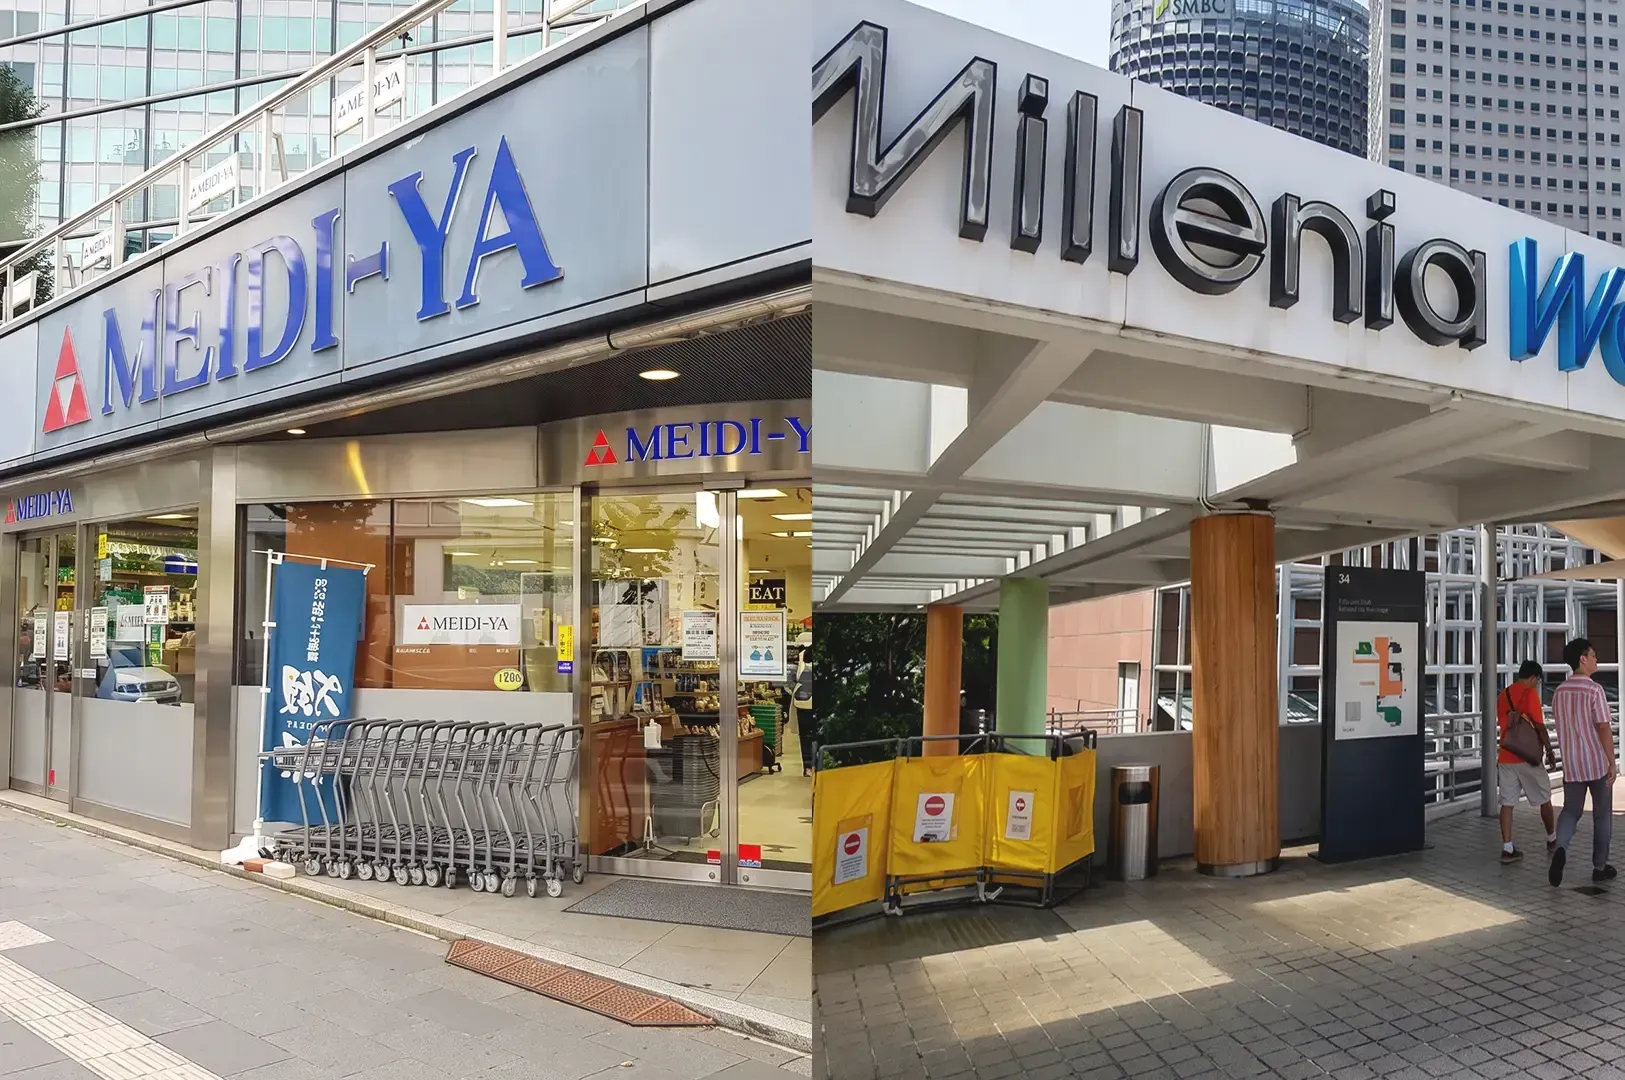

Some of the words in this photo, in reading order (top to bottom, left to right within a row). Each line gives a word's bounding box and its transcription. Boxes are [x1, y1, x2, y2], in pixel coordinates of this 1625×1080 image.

[1172, 0, 1226, 15] SMBC
[197, 164, 234, 195] MEIDI-YA
[813, 20, 1486, 350] Millenia
[1509, 237, 1625, 384] W
[101, 134, 564, 416] MEIDI-YA
[16, 487, 74, 521] MEIDI-YA
[1338, 572, 1350, 584] 34
[433, 616, 509, 631] MEIDI-YA
